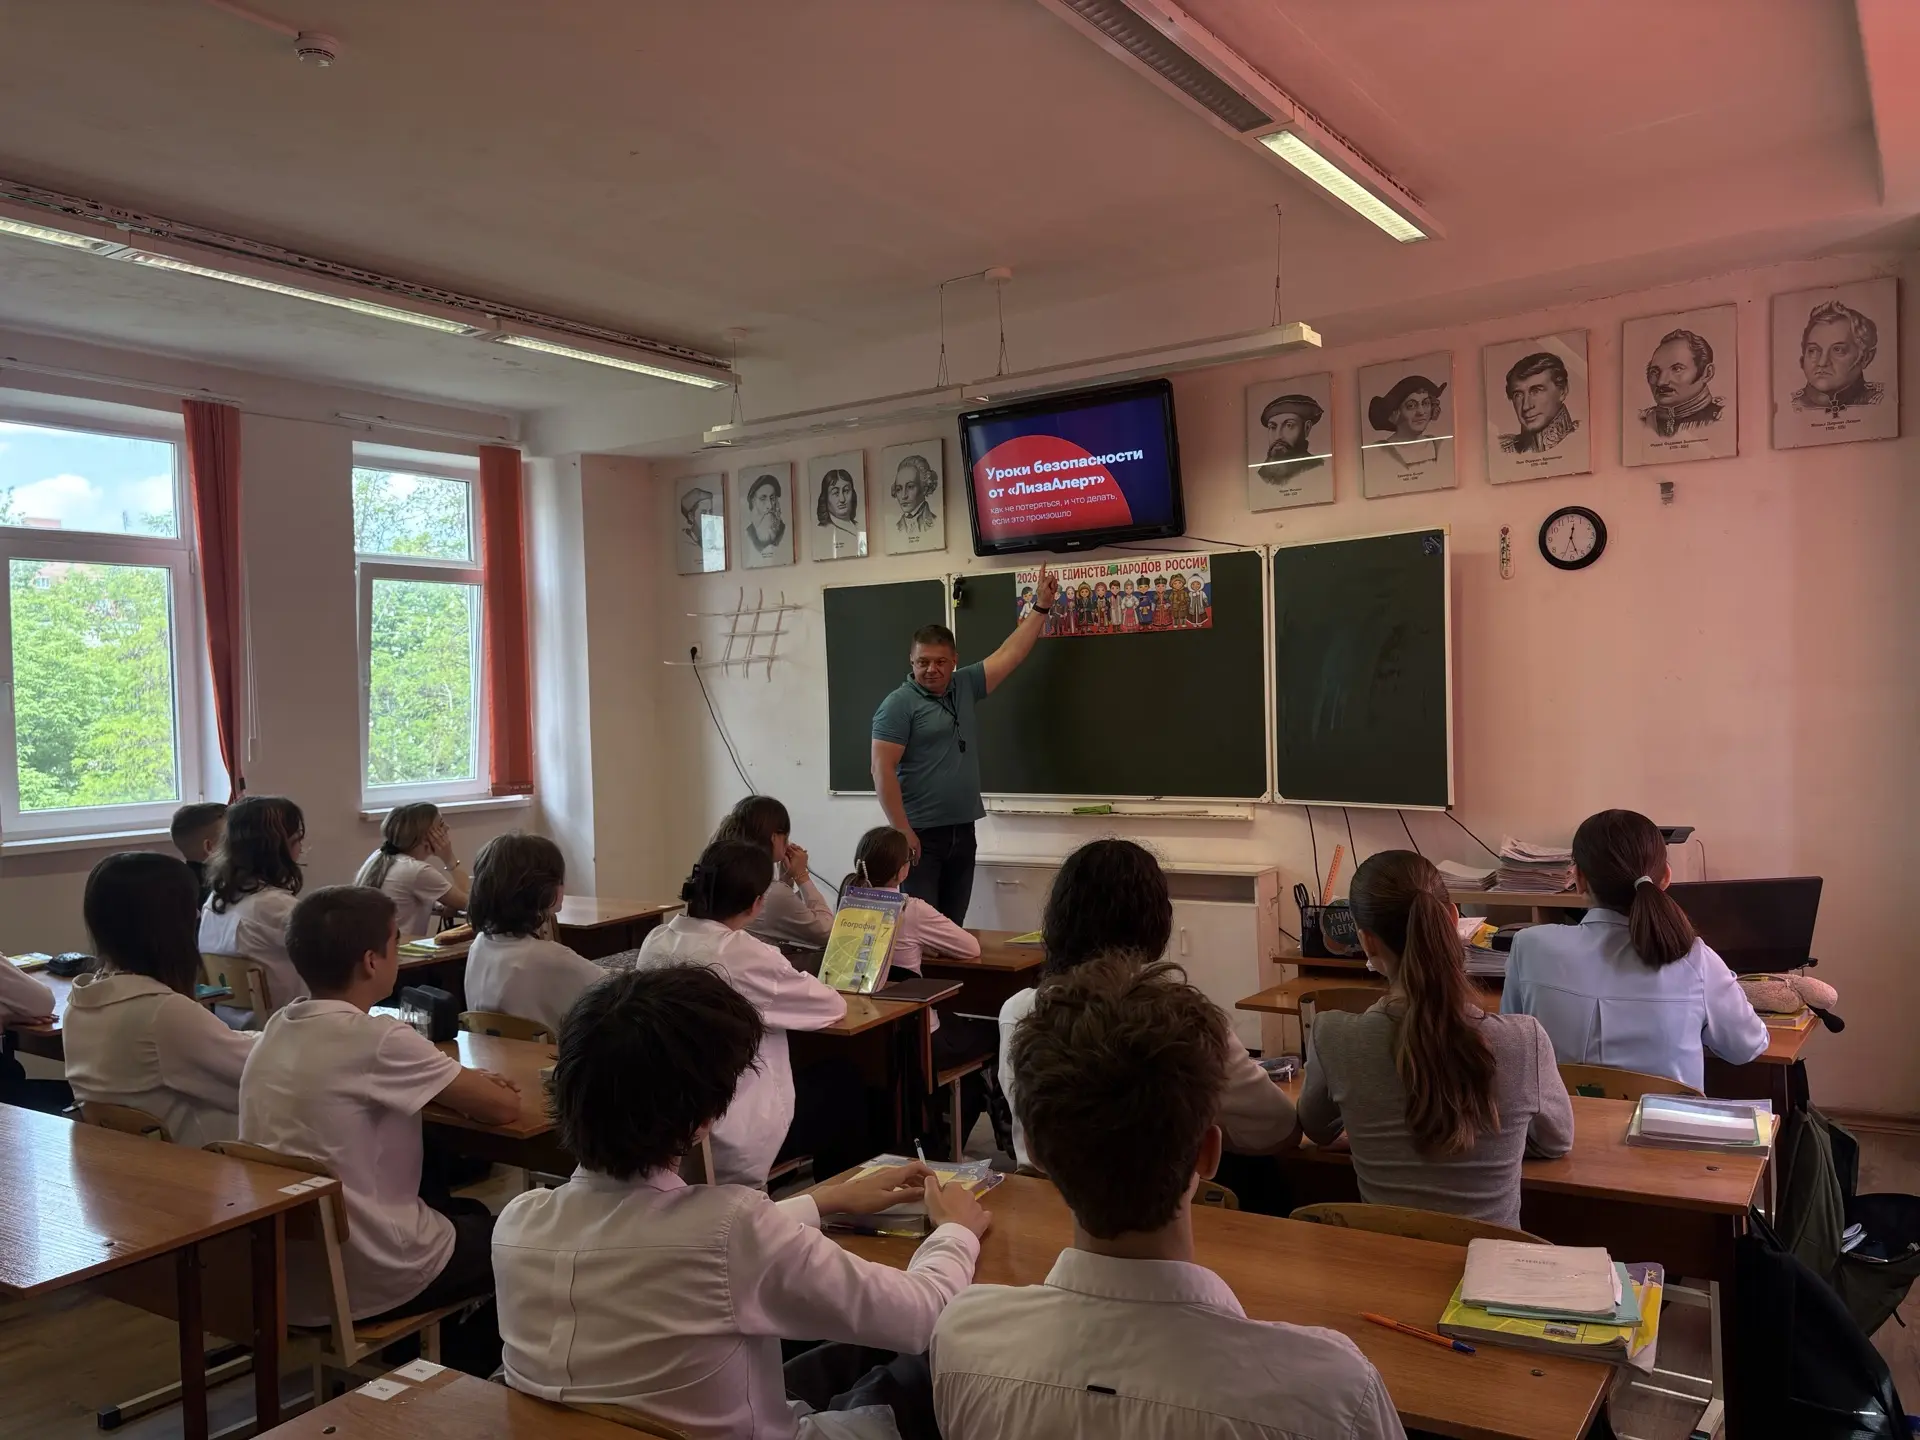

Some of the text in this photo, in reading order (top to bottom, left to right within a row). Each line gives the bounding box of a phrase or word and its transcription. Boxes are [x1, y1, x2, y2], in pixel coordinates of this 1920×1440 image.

[985, 449, 1144, 481] Уроки безопасности
[988, 475, 1106, 498] от «ЛизаАлерт»
[990, 506, 1004, 514] как
[1004, 505, 1015, 513] не
[1070, 497, 1086, 505] что
[1086, 492, 1118, 504] делать,
[991, 510, 1072, 526] если это произошло
[1016, 572, 1037, 584] 2026
[1116, 561, 1161, 576] НАРОДОВ
[1165, 556, 1208, 572] РОССИИ
[840, 918, 876, 931] География
[1327, 911, 1352, 924] УЧИ
[881, 927, 890, 938] 7
[1331, 922, 1356, 936] ЛЕГК
